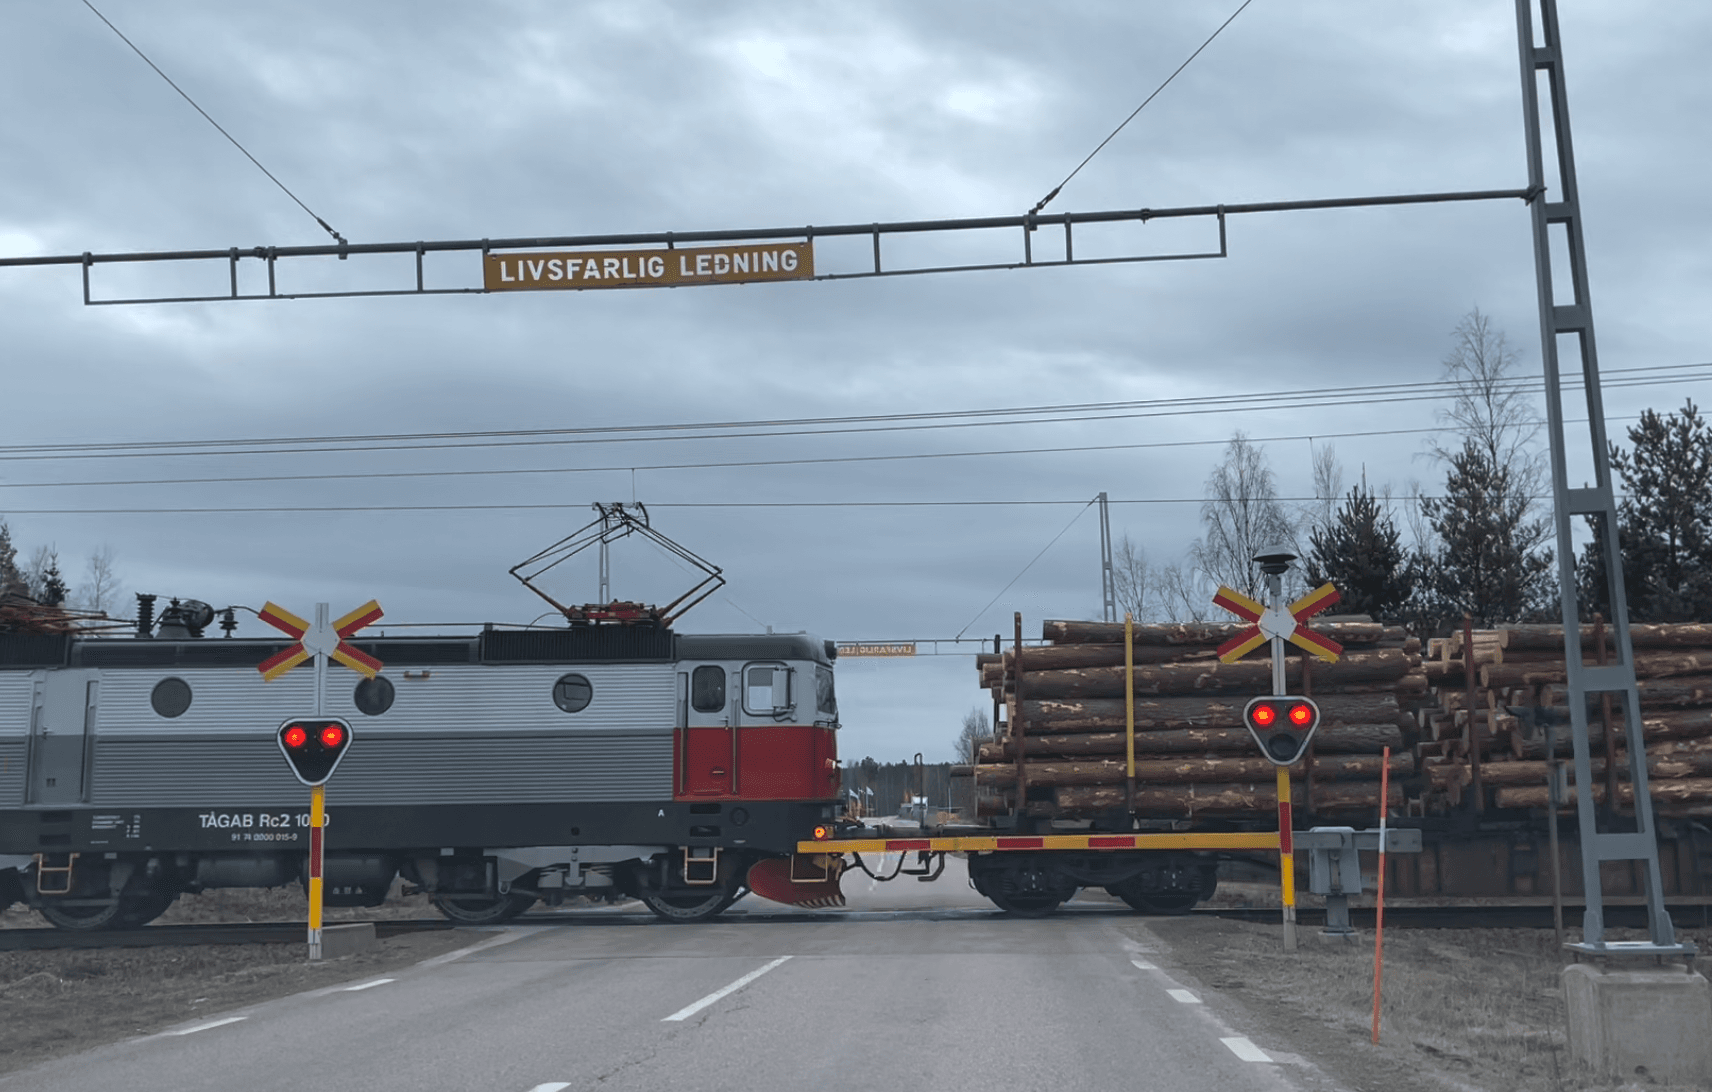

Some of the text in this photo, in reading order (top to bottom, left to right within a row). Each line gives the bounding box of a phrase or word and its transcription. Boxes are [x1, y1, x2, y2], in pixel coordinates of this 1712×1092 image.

[500, 249, 798, 282] LIVSFARLIG LEDNING
[198, 811, 330, 828] TÅGAB Rc2 100
[657, 809, 665, 817] A
